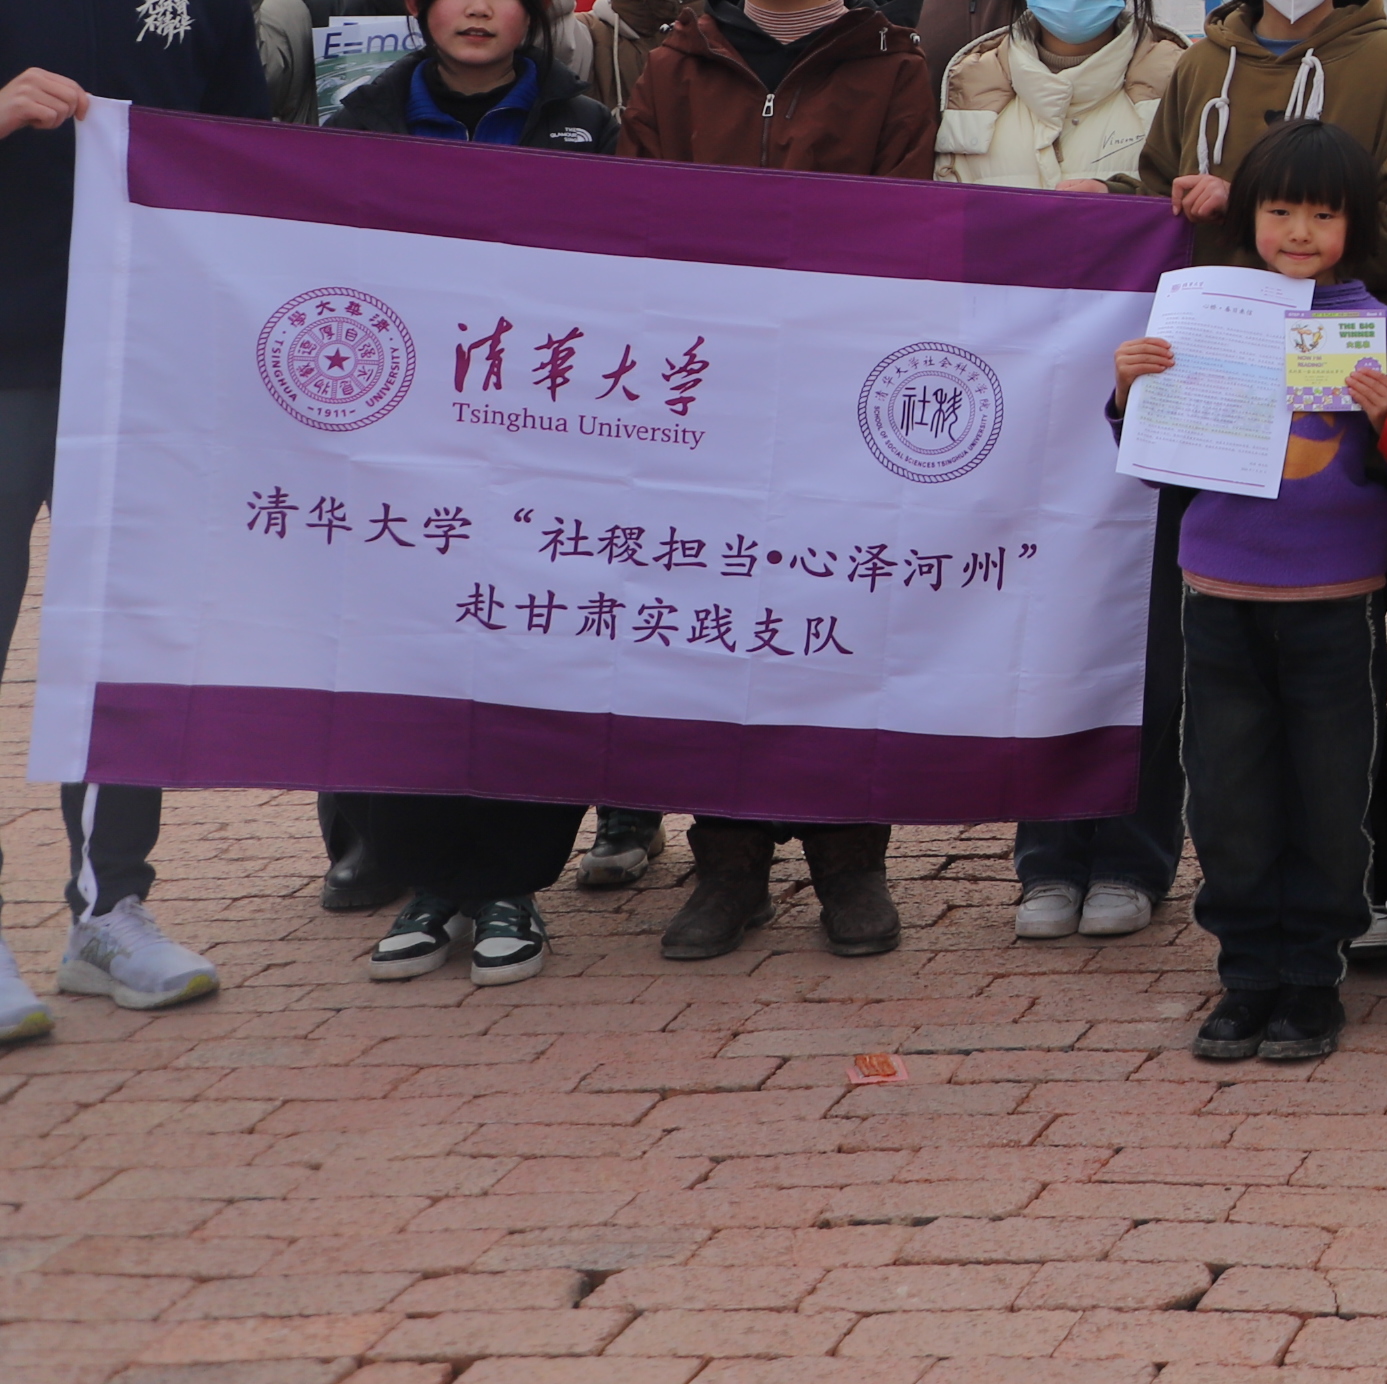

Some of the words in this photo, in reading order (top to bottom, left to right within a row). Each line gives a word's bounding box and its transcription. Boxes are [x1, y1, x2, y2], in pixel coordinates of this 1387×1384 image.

[271, 339, 298, 402] TSINGHUA
[366, 346, 400, 407] UNIVERSITY
[451, 400, 569, 440] Tsinghua
[578, 412, 706, 452] University
[455, 582, 855, 657] 赴甘肃实践支队
